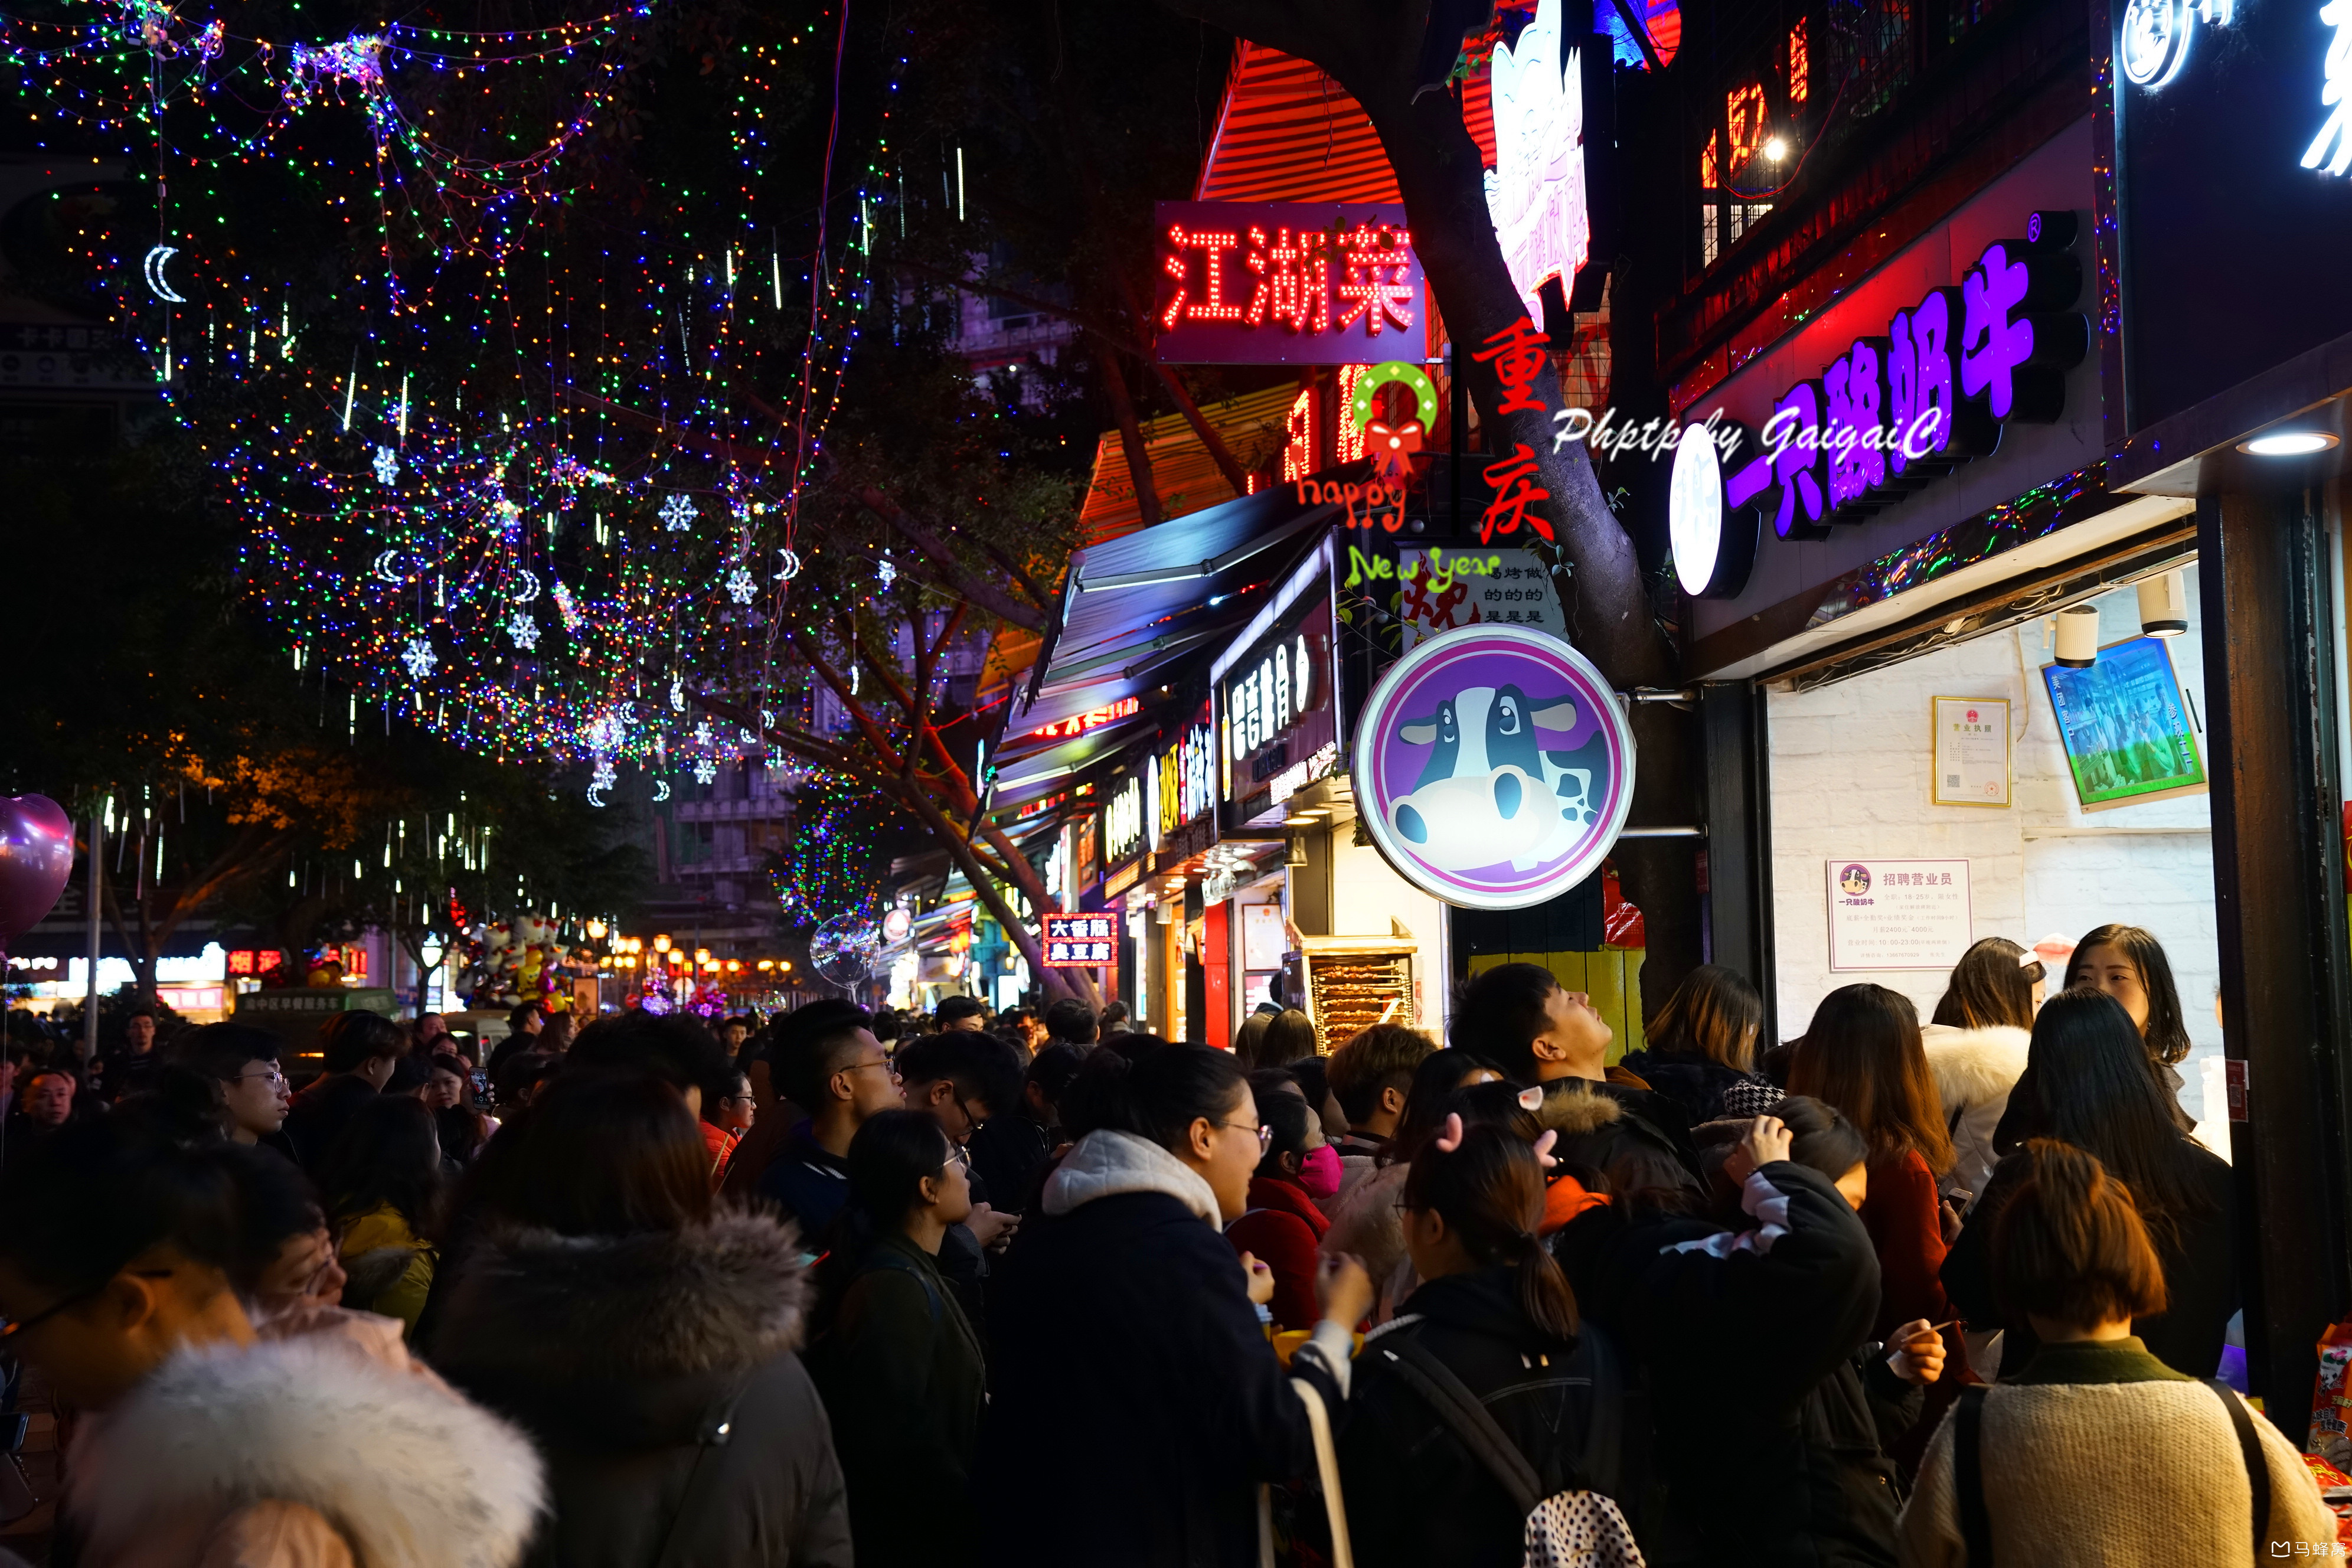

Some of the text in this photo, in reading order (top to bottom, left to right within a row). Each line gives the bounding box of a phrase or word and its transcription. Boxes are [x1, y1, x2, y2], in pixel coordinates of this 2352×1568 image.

[1163, 224, 1415, 334] 江湖菜
[1727, 243, 2034, 541] 一只酸奶牛
[1953, 723, 1992, 733] 营业执照
[1883, 872, 1952, 886] 招聘营业员
[1838, 898, 1875, 906] 一只酸奶牛
[1051, 919, 1109, 937] 大香肠
[1050, 942, 1110, 961] 臭豆腐
